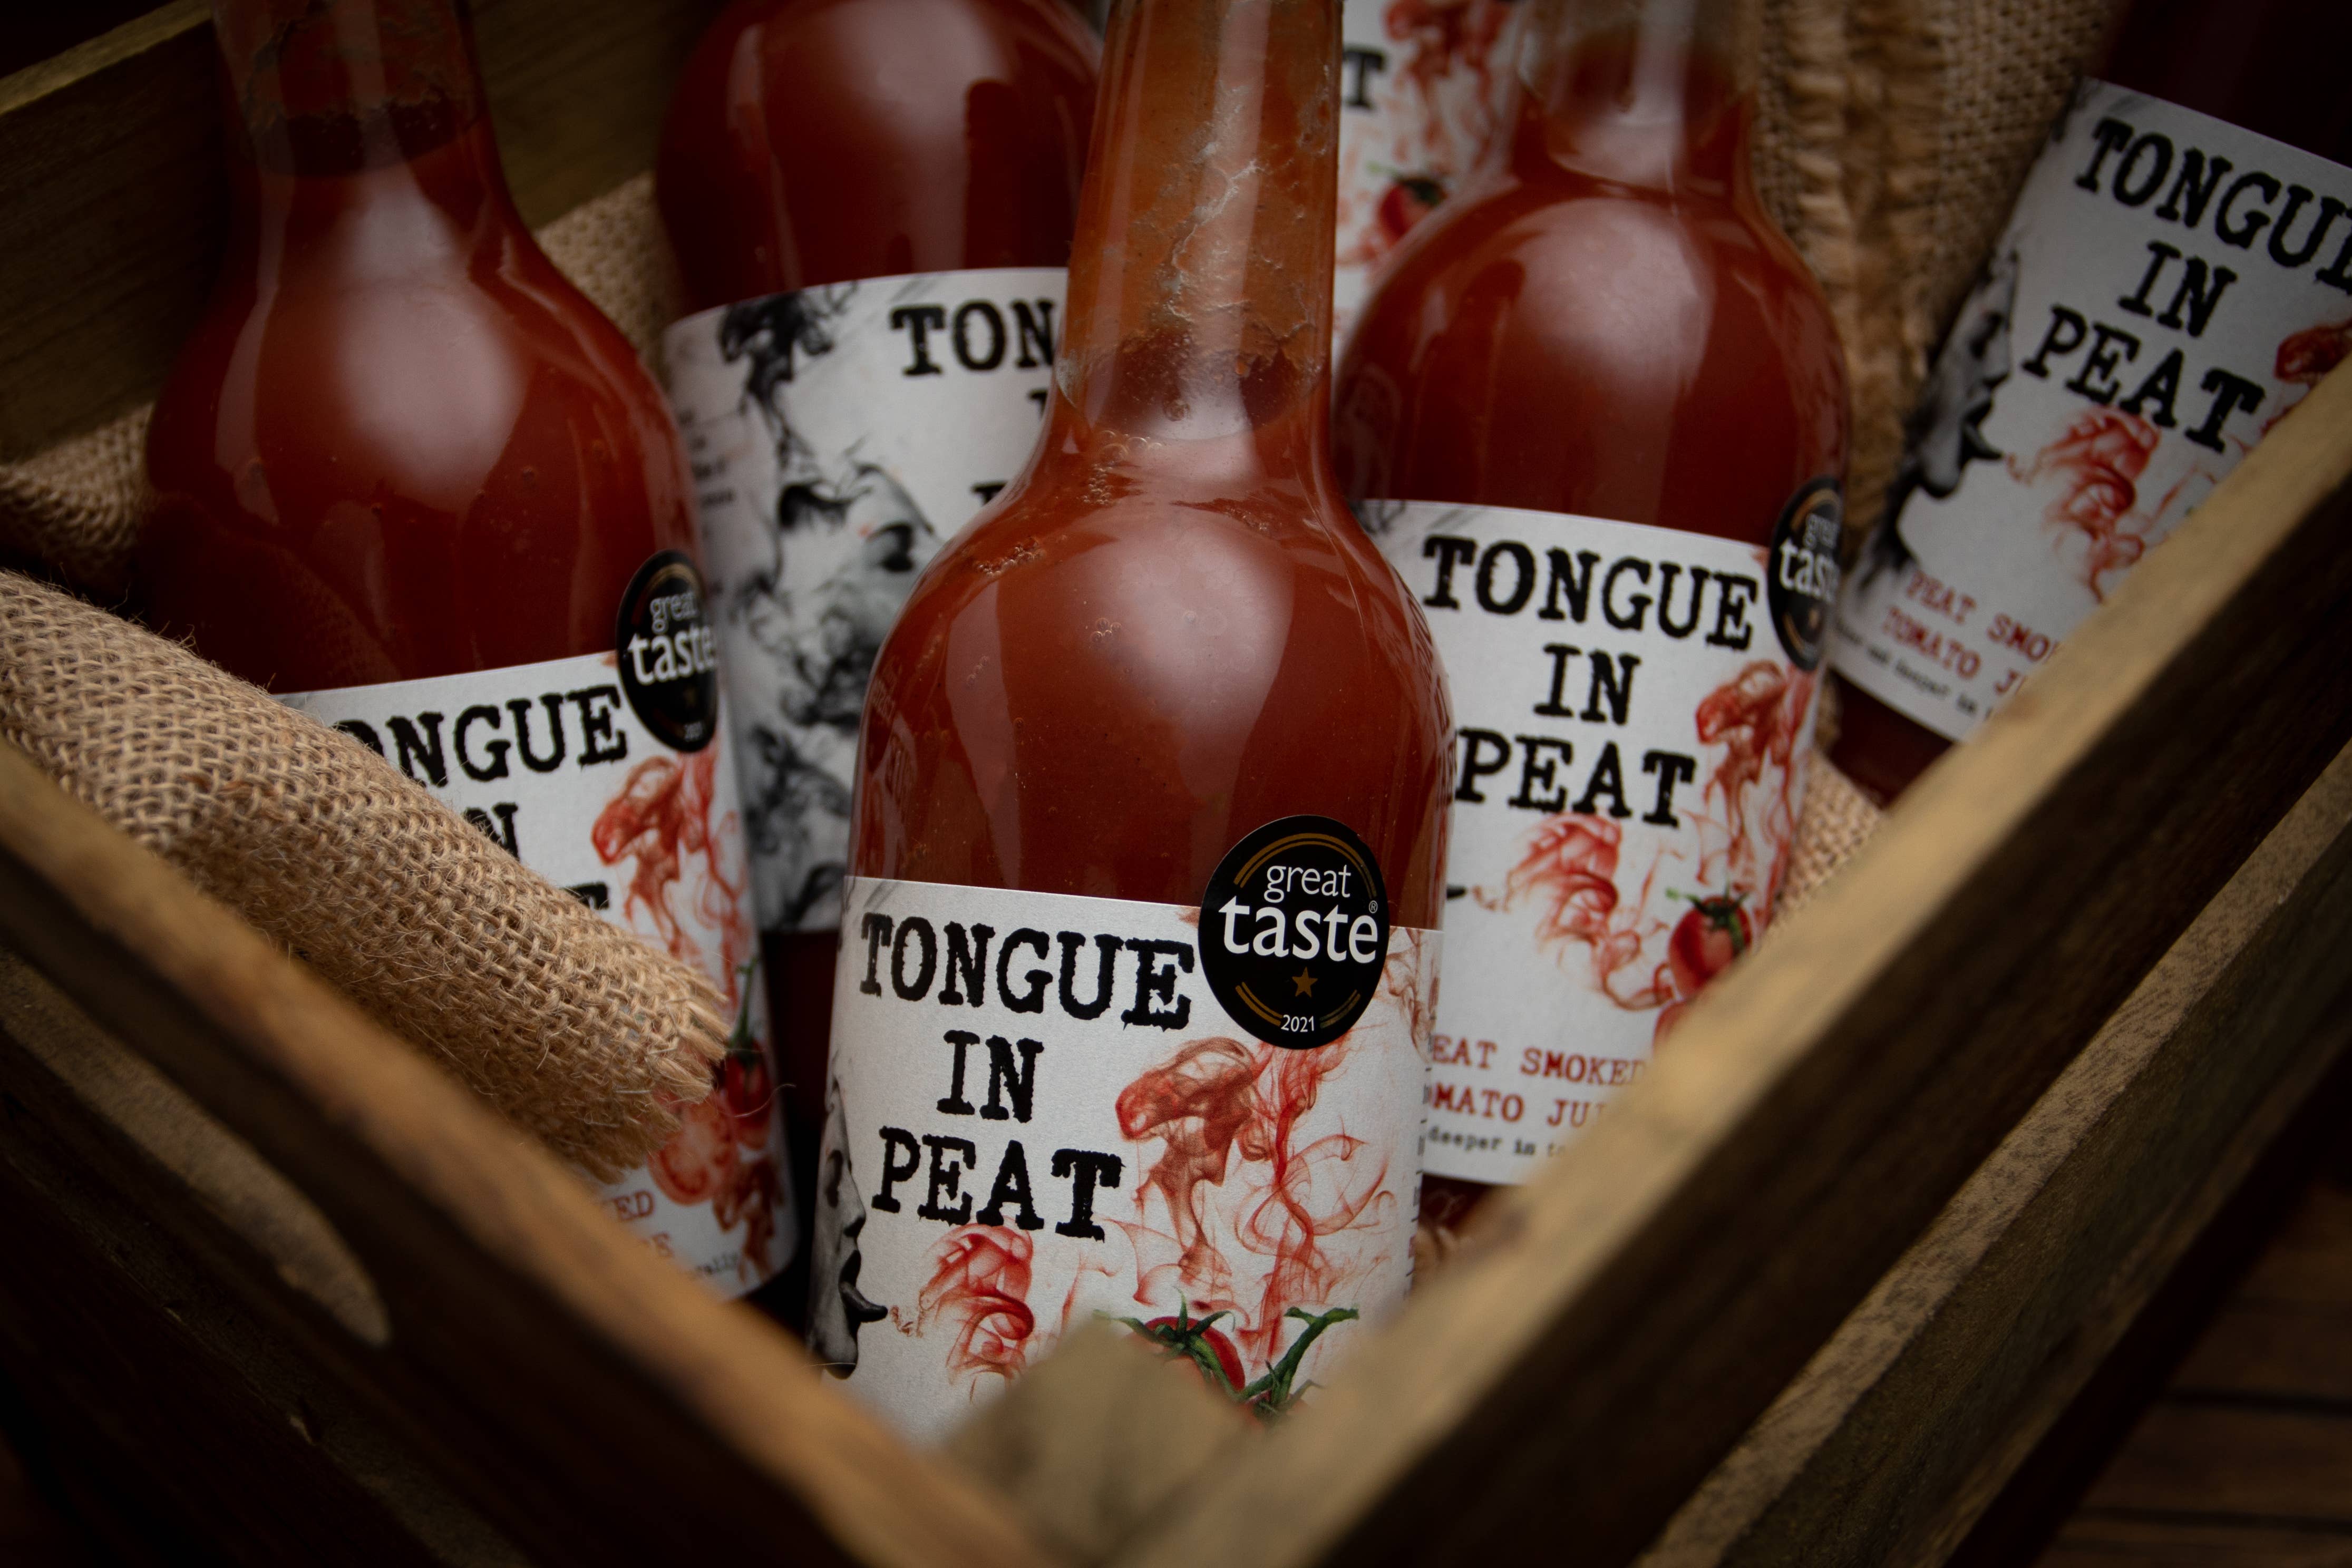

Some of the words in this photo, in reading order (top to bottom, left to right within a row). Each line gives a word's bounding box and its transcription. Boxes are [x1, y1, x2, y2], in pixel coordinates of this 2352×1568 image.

[2118, 240, 2238, 339] IN
[890, 299, 1055, 377] TON
[2021, 304, 2267, 454] PEAT
[1423, 535, 1758, 651] TONGUE
[1533, 643, 1641, 725] IN
[1455, 727, 1696, 829] PEAT
[1264, 865, 1351, 903] great
[860, 913, 1194, 1030] TONGUE
[1280, 1014, 1315, 1033] 2021
[1431, 1034, 1497, 1069] EAT
[937, 1031, 1044, 1123] IN
[1427, 1082, 1524, 1122] MATO
[871, 1126, 1125, 1243] PEAT
